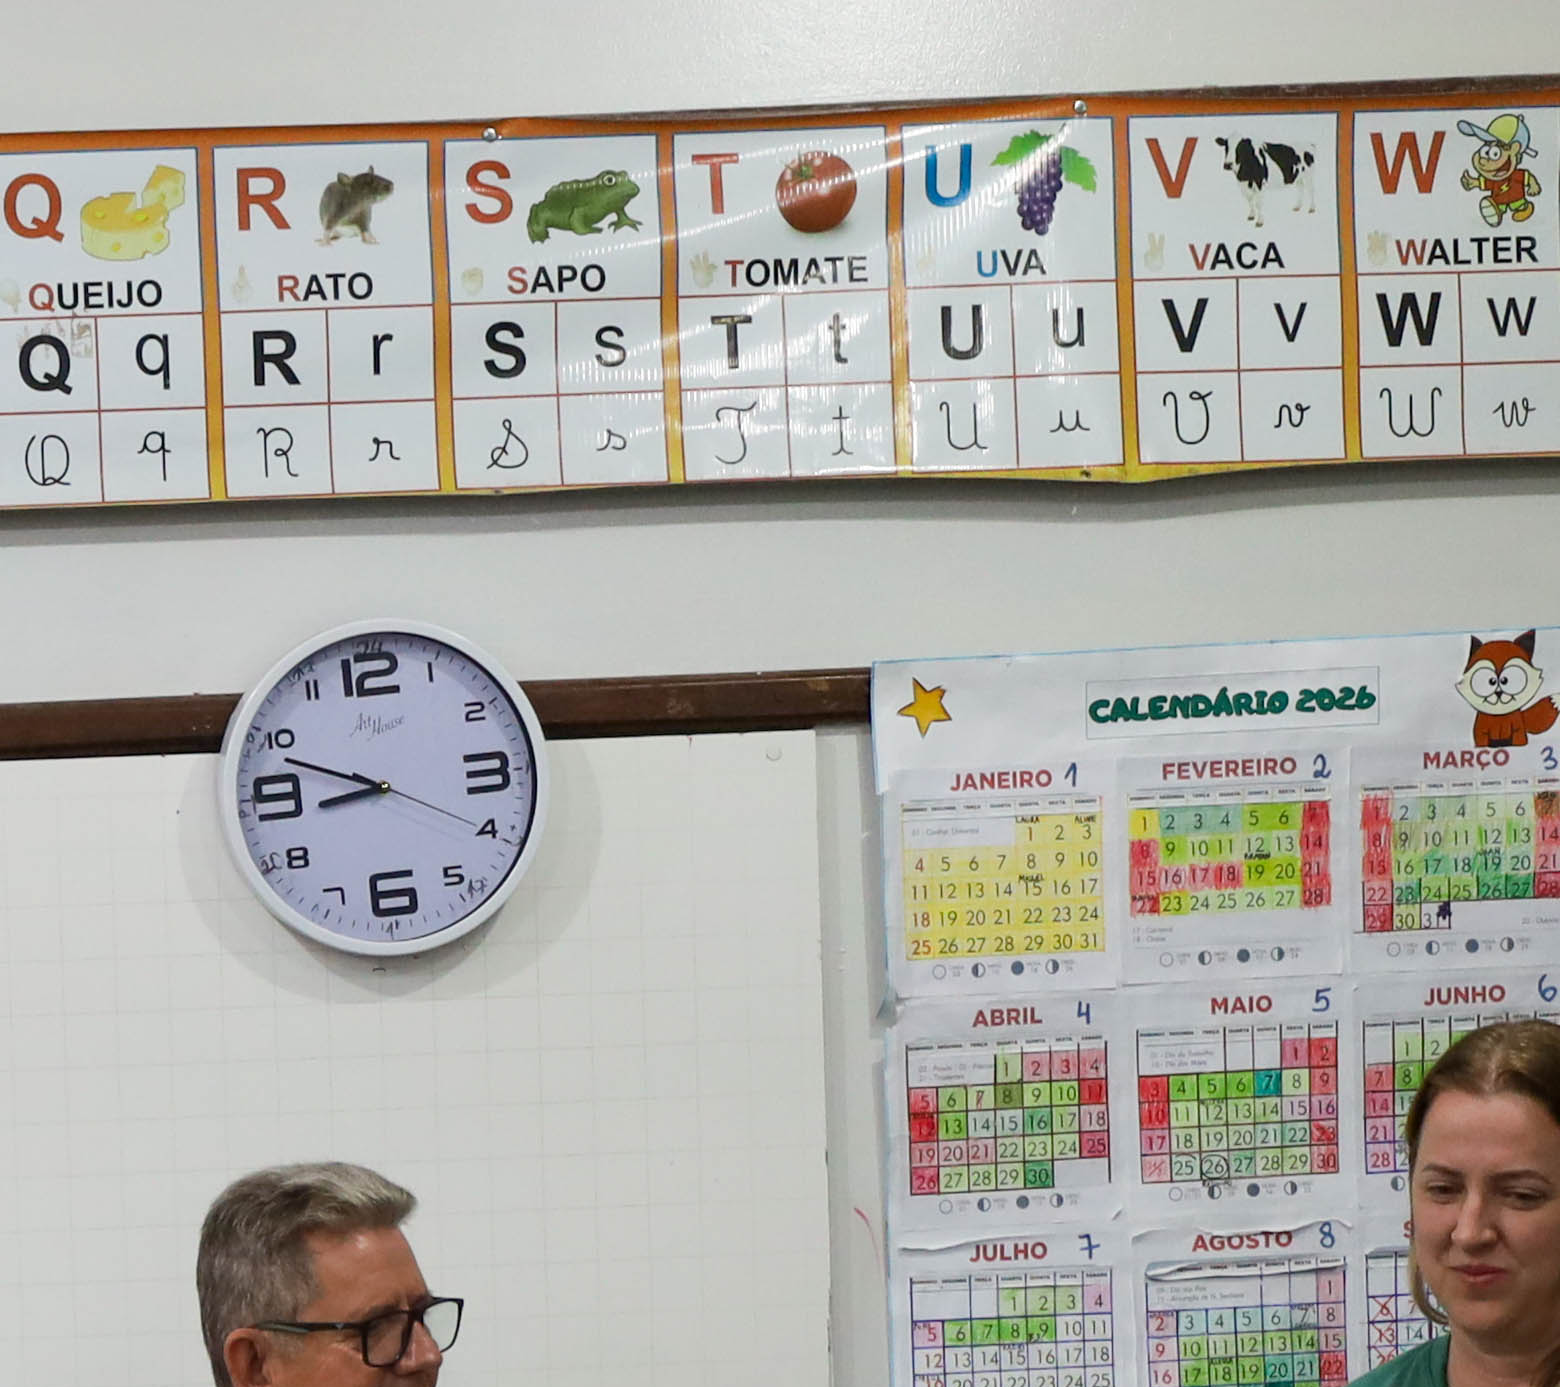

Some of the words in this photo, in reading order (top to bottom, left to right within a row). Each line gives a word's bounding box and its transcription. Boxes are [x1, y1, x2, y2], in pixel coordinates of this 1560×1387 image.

[974, 246, 1048, 279] UVA
[1188, 241, 1285, 273] VACA
[1394, 234, 1539, 268] WALTER
[277, 271, 374, 304] RATO
[506, 264, 607, 297] SAPO
[723, 255, 869, 290] TOMATE
[27, 279, 164, 316] QUEIJO
[340, 651, 401, 698] 12
[1089, 688, 1289, 725] CALENDÁRIO
[1295, 686, 1376, 713] 2026
[463, 751, 511, 795] 3
[1162, 757, 1297, 780] FEVEREIRO
[1422, 748, 1510, 771] MARÇO
[951, 769, 1052, 792] JANEIRO
[253, 773, 303, 822] 9
[369, 869, 418, 918] 6
[1211, 994, 1273, 1016] MAIO
[1423, 985, 1506, 1006] JUNHO
[972, 1006, 1043, 1028] ABRIL
[970, 1242, 1048, 1262] JULHO
[1191, 1231, 1293, 1253] AGOSTO
